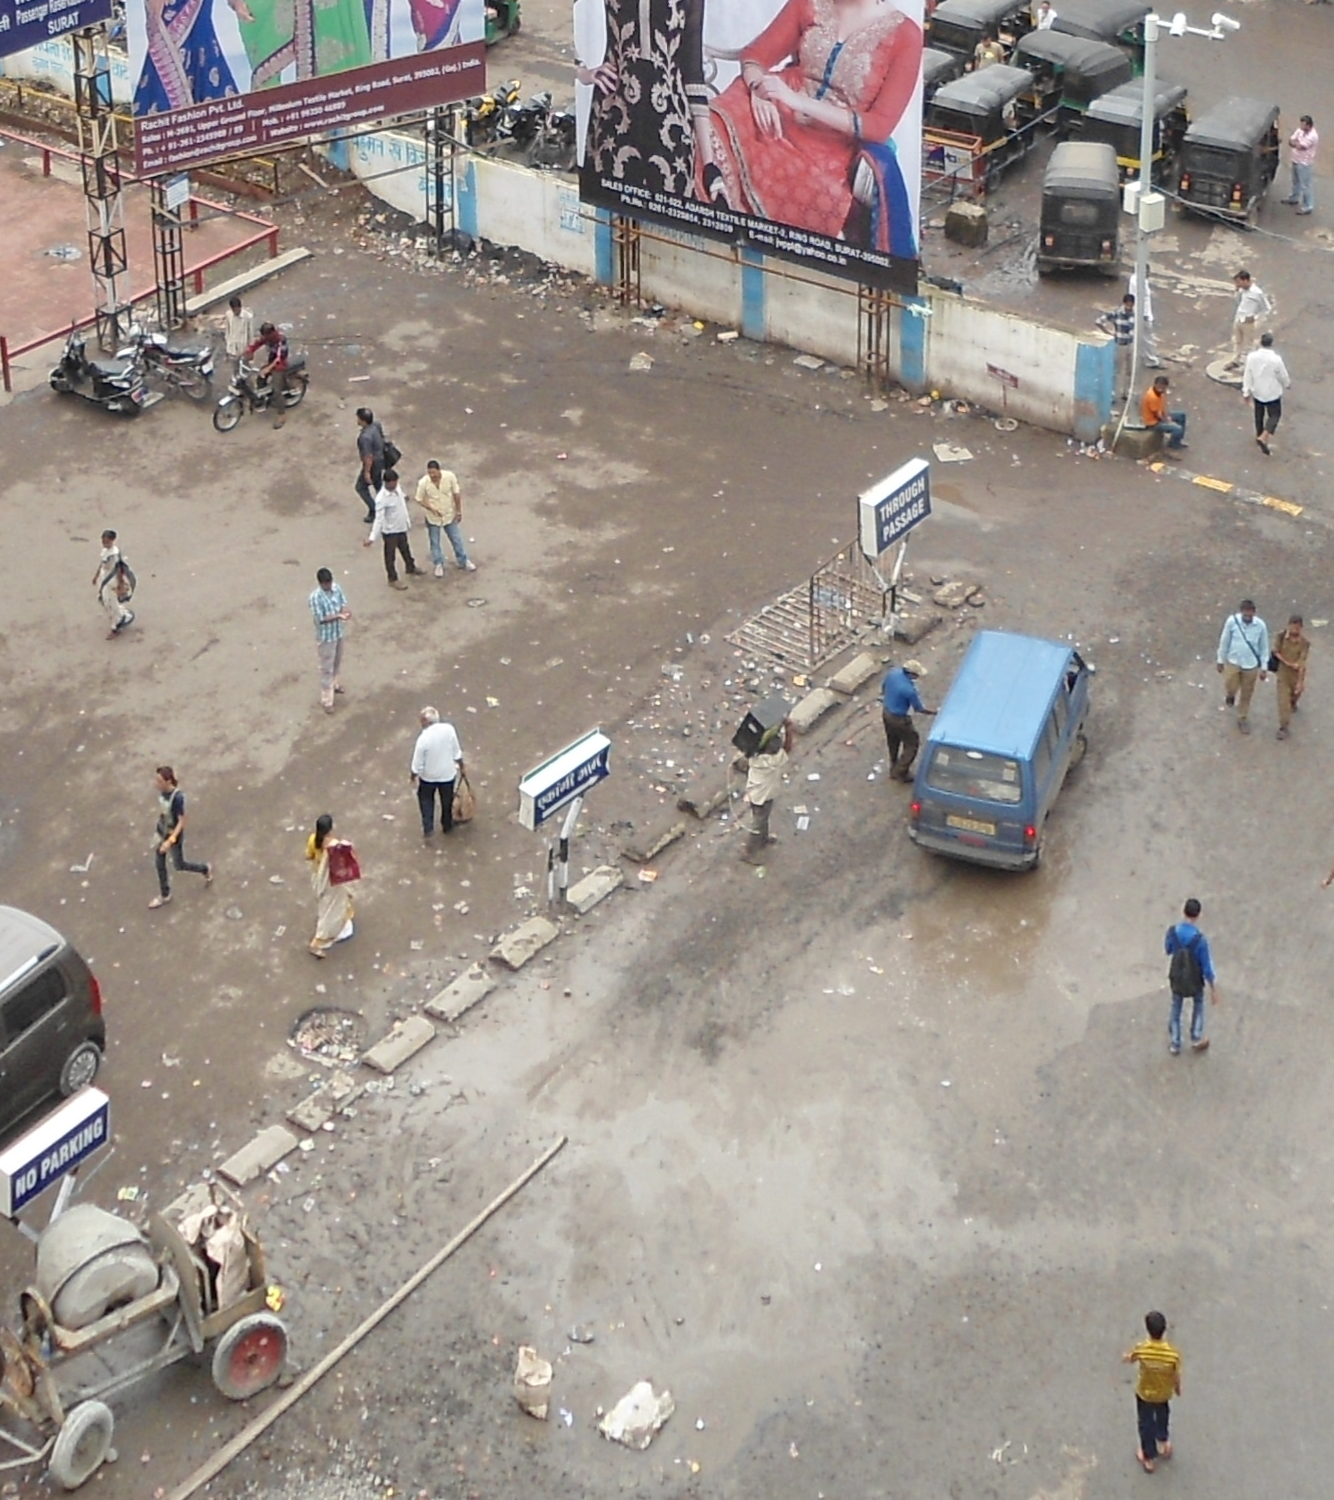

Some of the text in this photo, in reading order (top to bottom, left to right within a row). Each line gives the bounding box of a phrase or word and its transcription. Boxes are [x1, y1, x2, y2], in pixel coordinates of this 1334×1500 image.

[15, 0, 48, 26] Passenger
[47, 11, 79, 35] SURAT
[140, 100, 245, 132] Rachit Fashion Pvt. Ltd.
[600, 178, 624, 193] SALES
[684, 202, 715, 219] ADARSH
[716, 210, 746, 227] TEXTILE
[788, 229, 808, 243] RING
[879, 475, 926, 524] THROUGH
[881, 498, 926, 543] PASSAGE
[13, 1116, 104, 1199] NO PARKING
